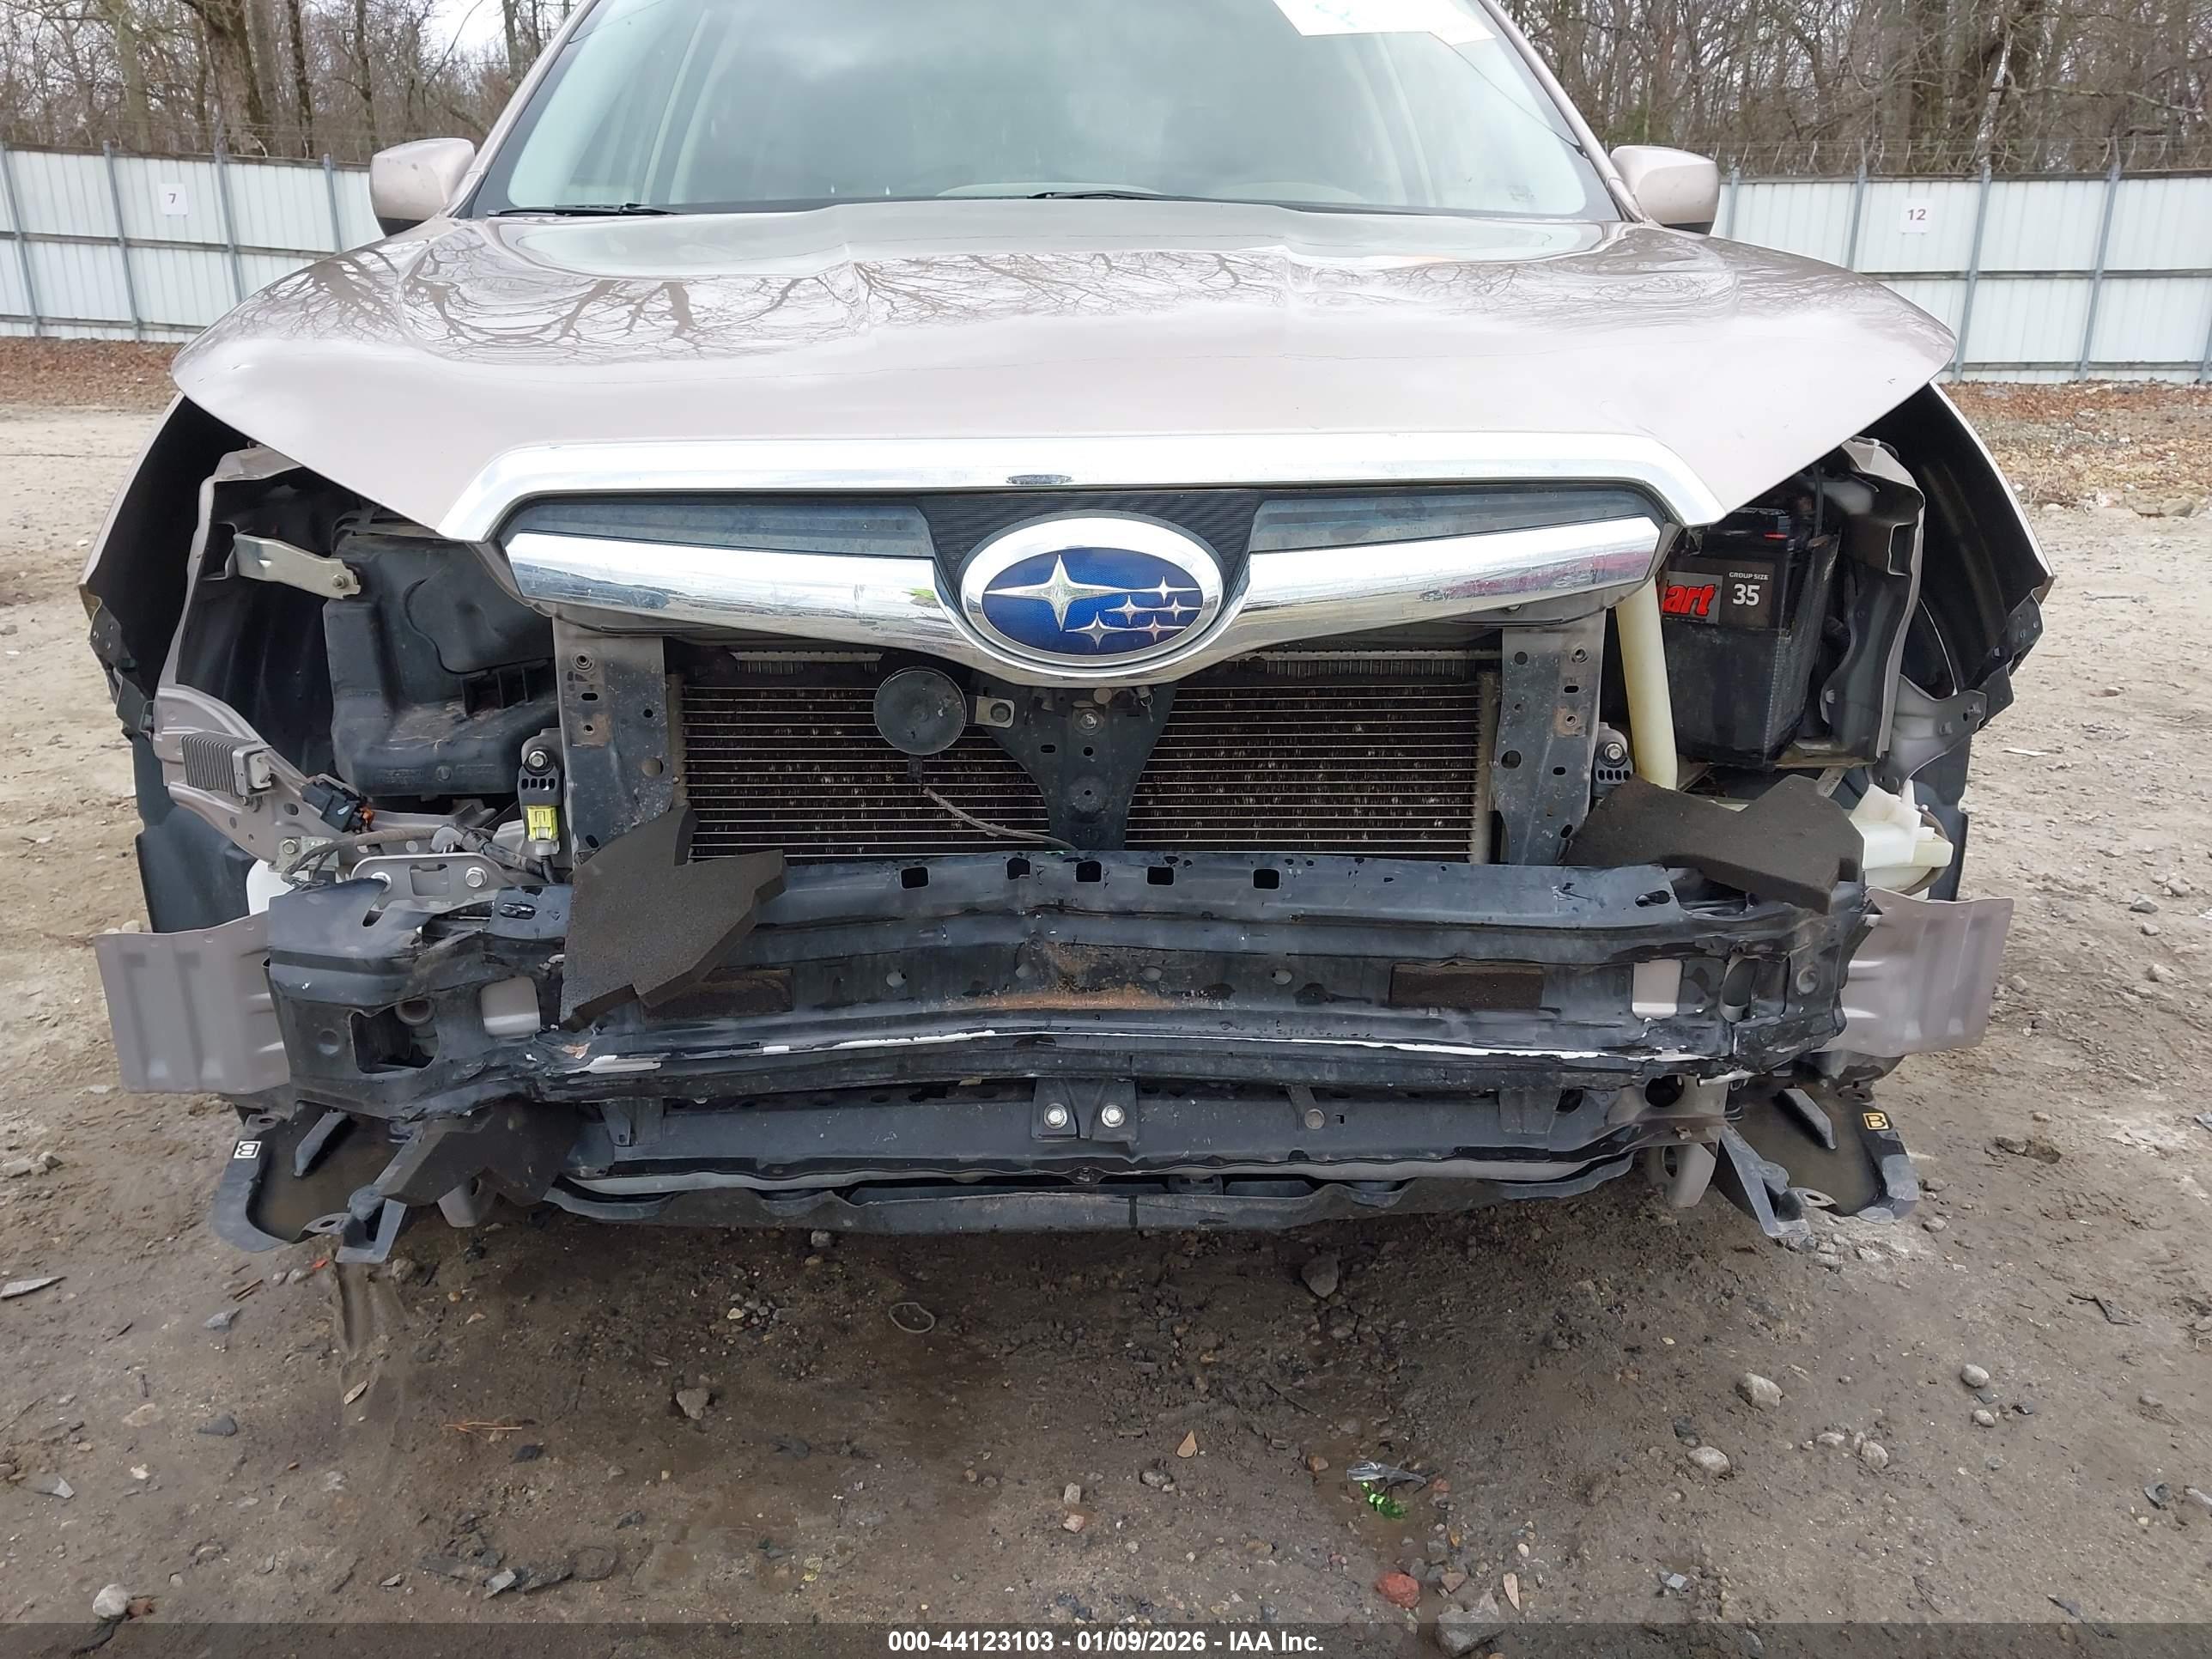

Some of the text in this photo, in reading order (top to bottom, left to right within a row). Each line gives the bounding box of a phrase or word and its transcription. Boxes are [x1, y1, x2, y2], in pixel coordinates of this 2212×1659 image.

[167, 192, 176, 204] 7
[1906, 209, 1926, 221] 12
[1729, 571, 1770, 581] GROUP SIZE
[1662, 583, 1717, 617] art
[1732, 583, 1760, 606] 35
